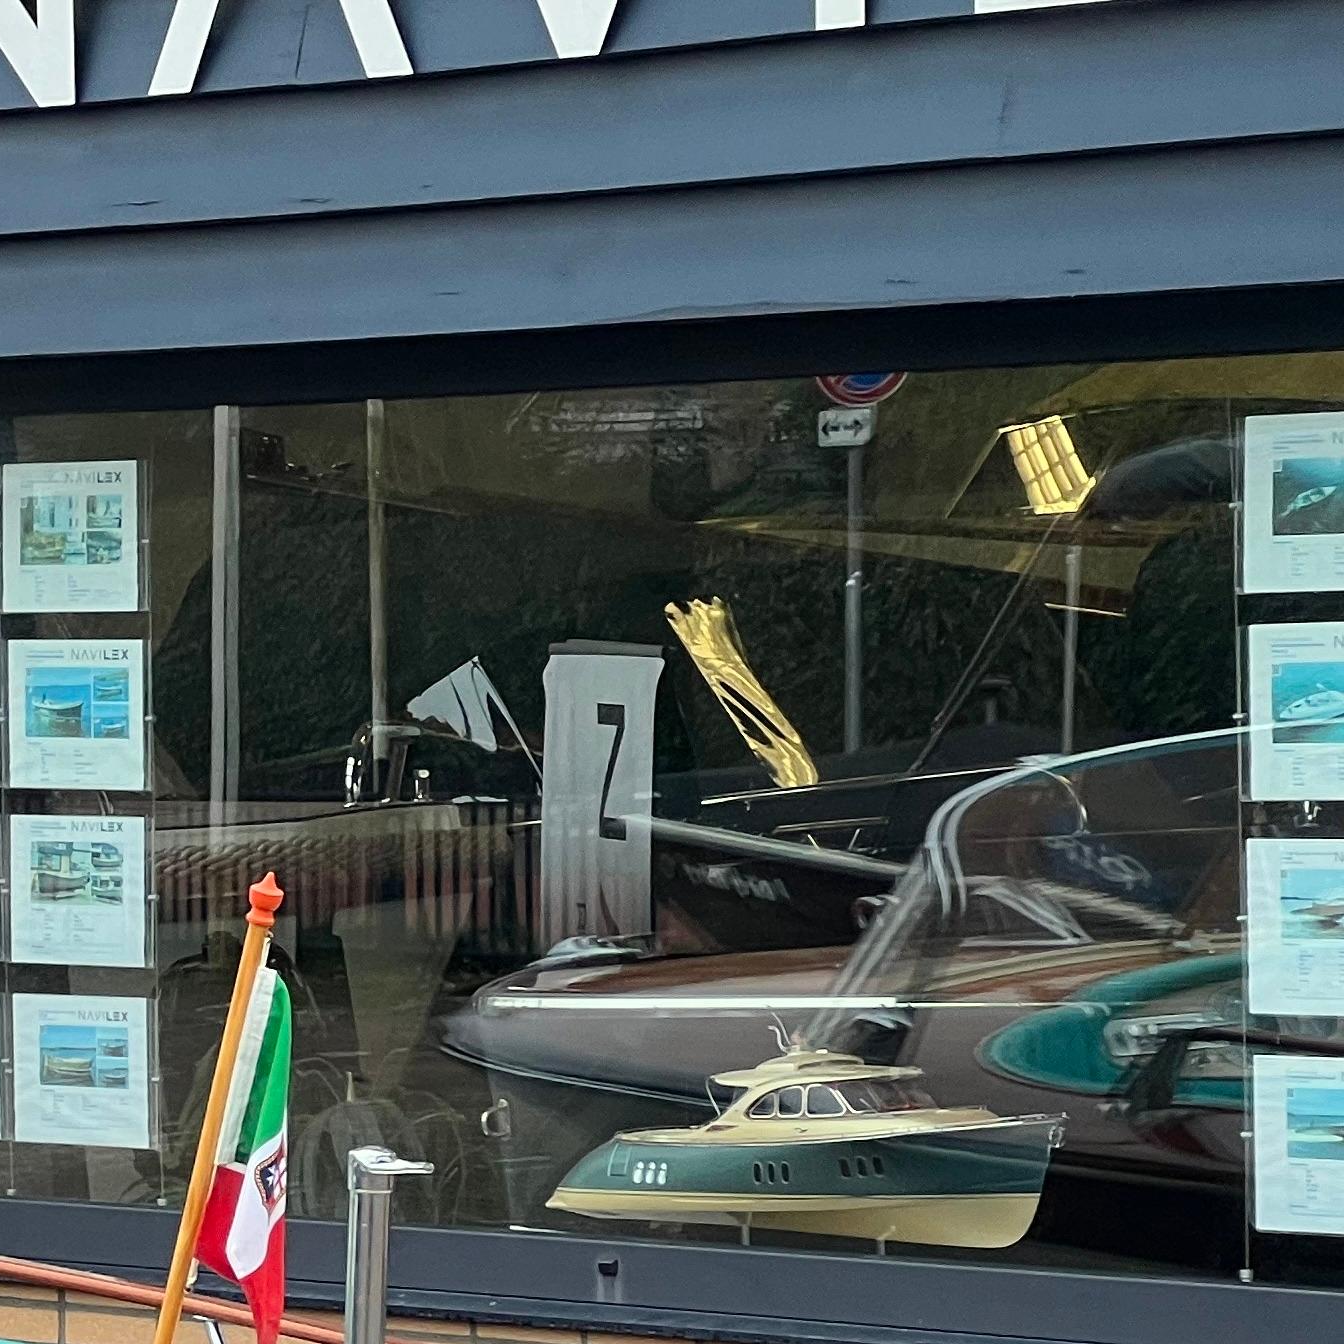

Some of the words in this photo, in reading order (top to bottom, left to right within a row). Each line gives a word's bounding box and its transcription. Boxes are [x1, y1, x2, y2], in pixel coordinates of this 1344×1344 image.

[70, 649, 129, 660] NAVILEX
[70, 821, 124, 832] NAVILEX
[78, 1010, 128, 1022] NAVILEX
